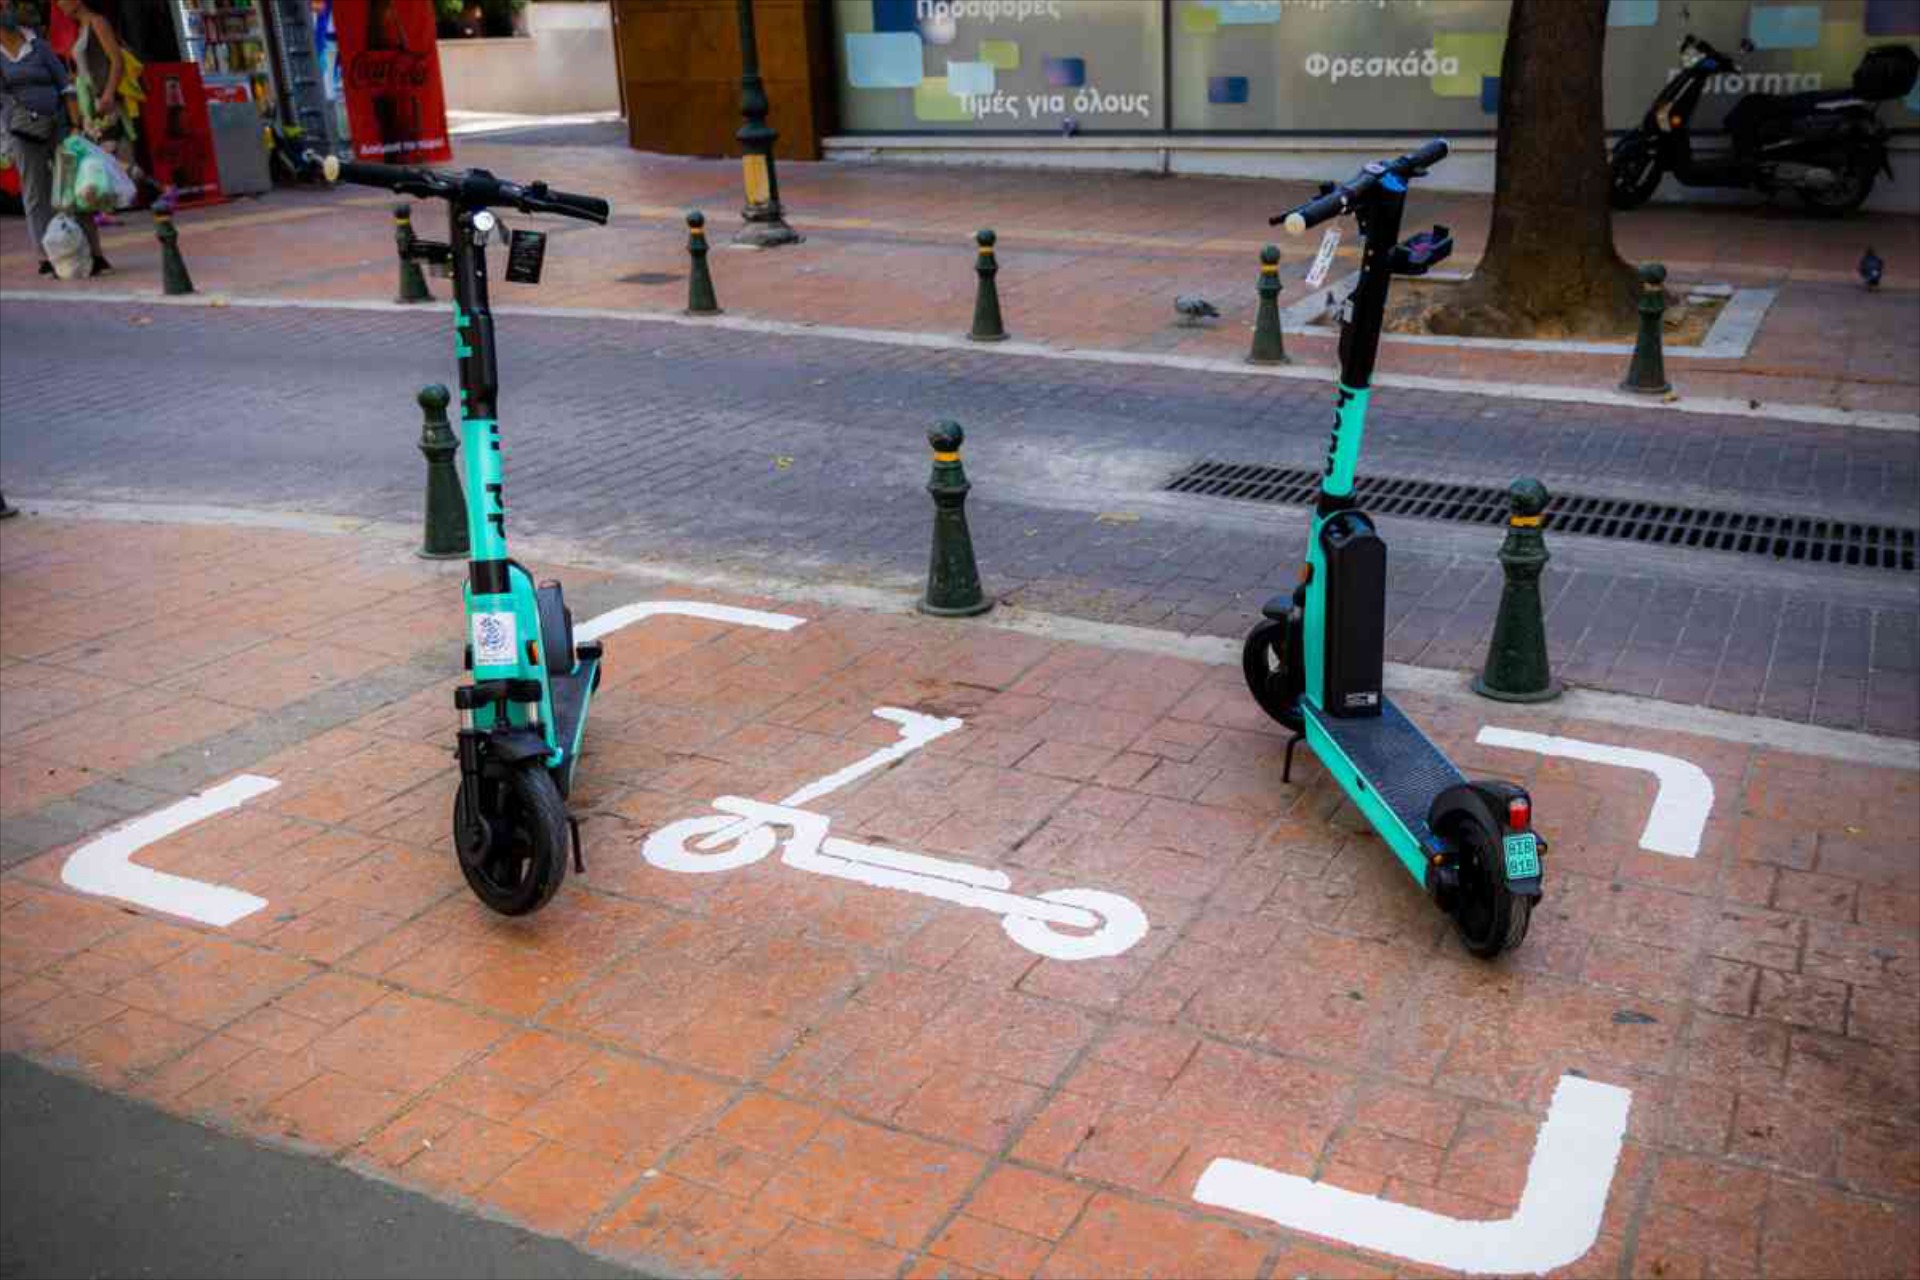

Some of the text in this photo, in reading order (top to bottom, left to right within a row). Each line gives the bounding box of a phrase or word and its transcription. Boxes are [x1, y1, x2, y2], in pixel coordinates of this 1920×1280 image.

[1304, 49, 1459, 83] Φρεσκάδα
[956, 86, 1149, 119] Τιμές για όλους
